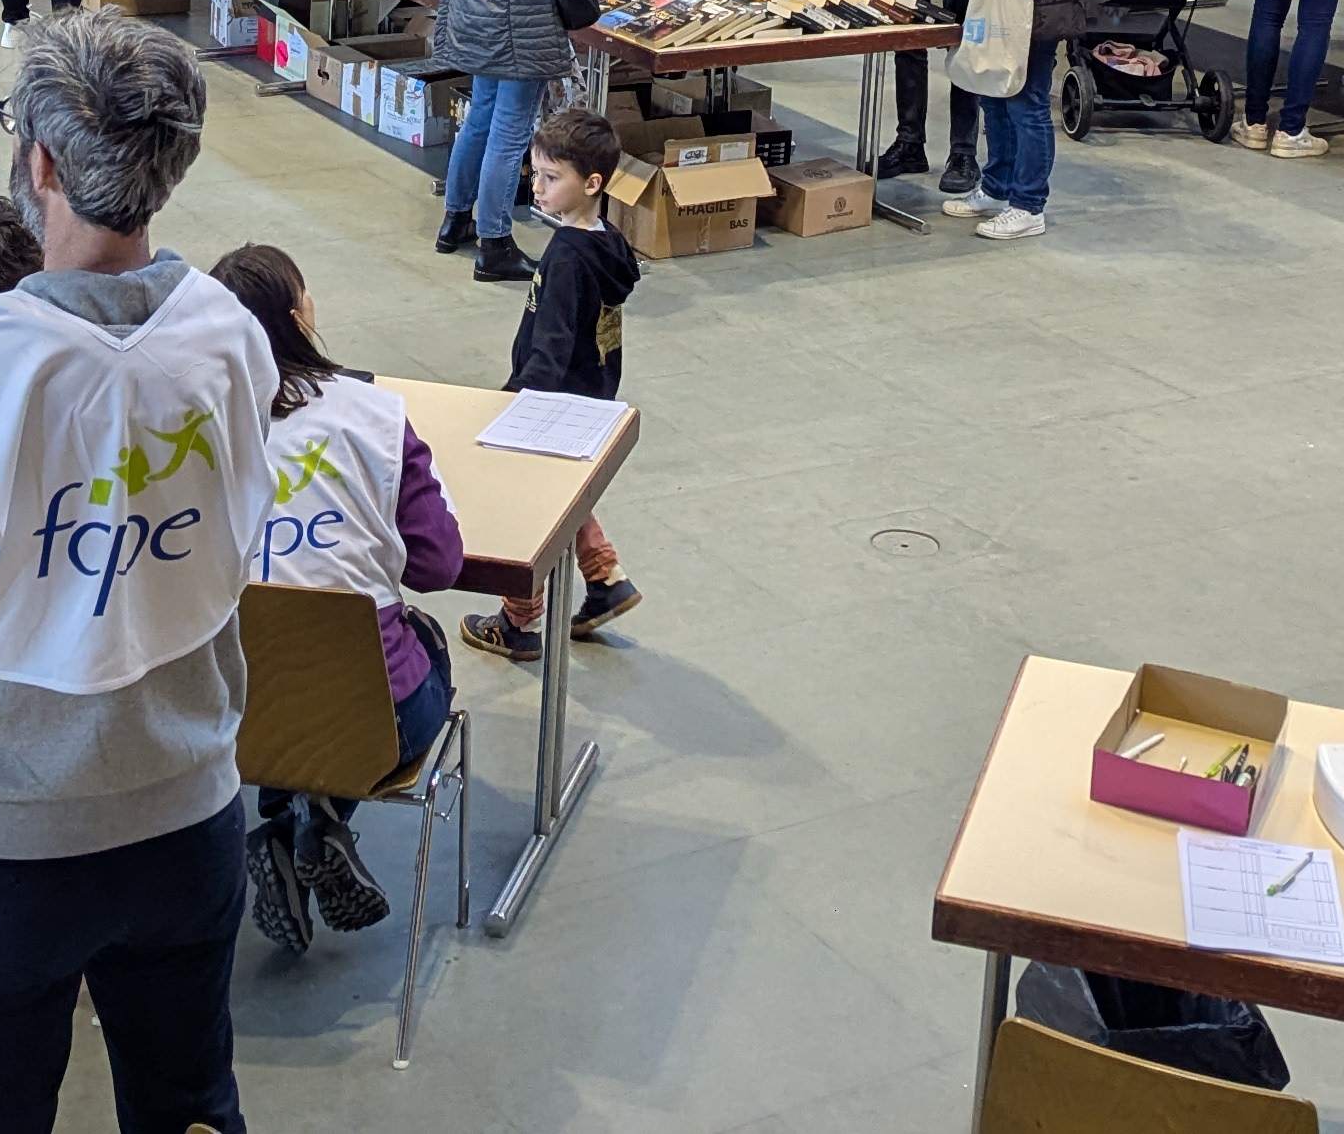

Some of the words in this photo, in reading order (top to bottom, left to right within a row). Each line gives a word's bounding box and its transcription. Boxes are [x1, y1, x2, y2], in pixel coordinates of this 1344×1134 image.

[677, 198, 737, 217] FRAGILE
[729, 218, 749, 230] BAS
[32, 482, 201, 617] fcpe
[253, 510, 344, 583] pe
